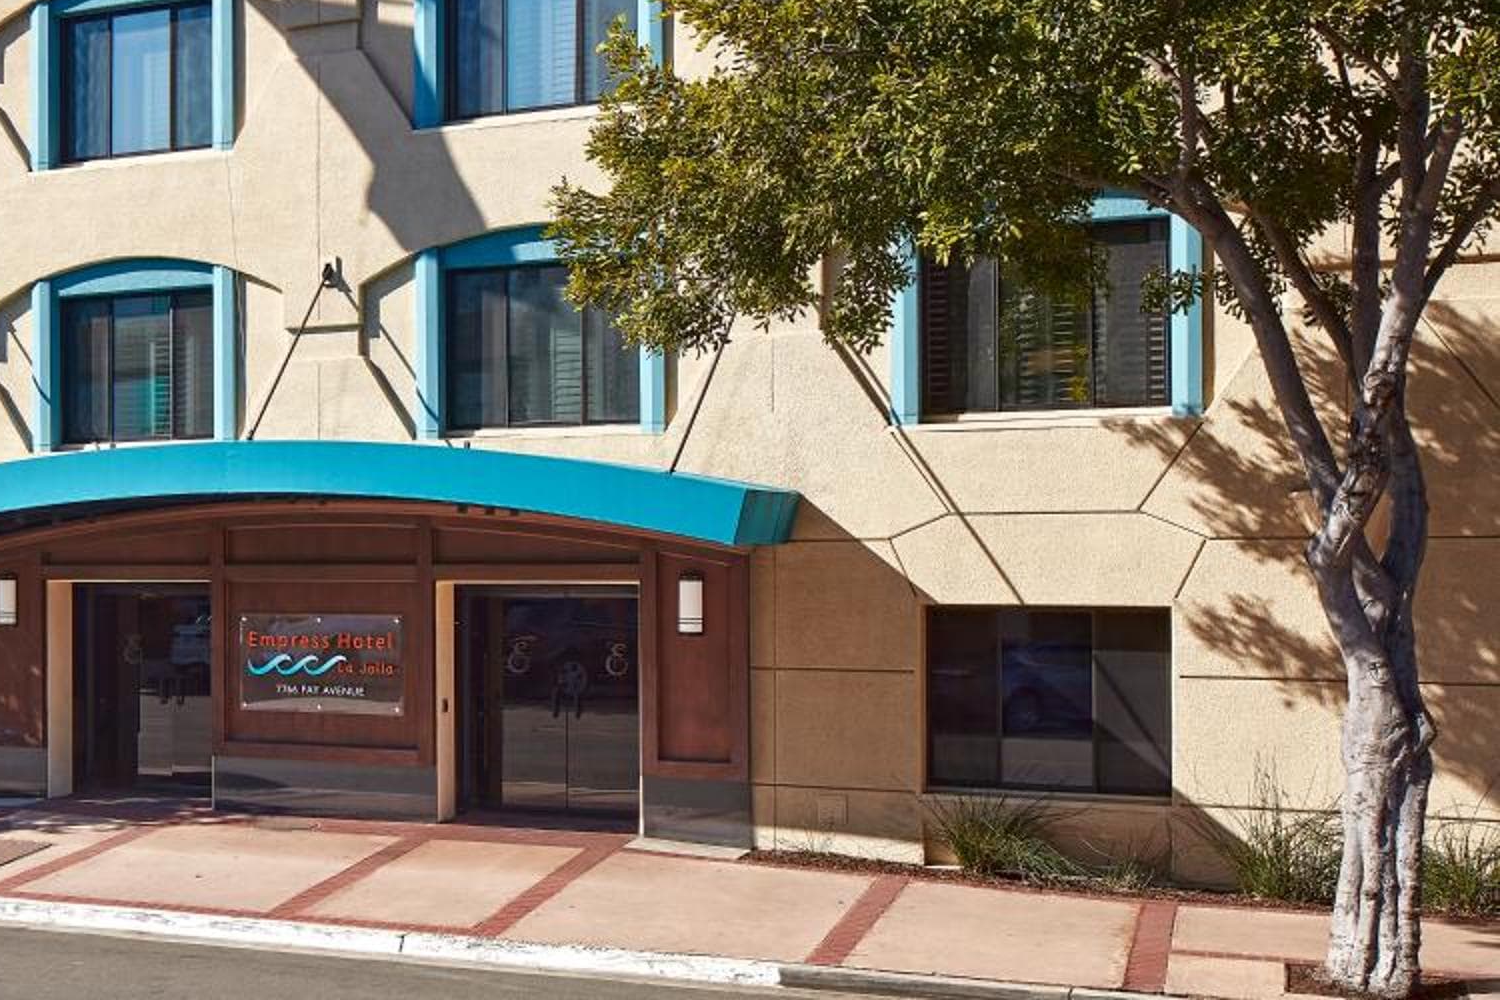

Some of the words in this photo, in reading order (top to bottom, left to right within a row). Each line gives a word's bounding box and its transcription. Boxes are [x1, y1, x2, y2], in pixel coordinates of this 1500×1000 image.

[247, 631, 330, 651] Empress
[337, 632, 393, 649] Hotel
[359, 661, 394, 676] Jolla
[323, 686, 365, 697] AVENUE
